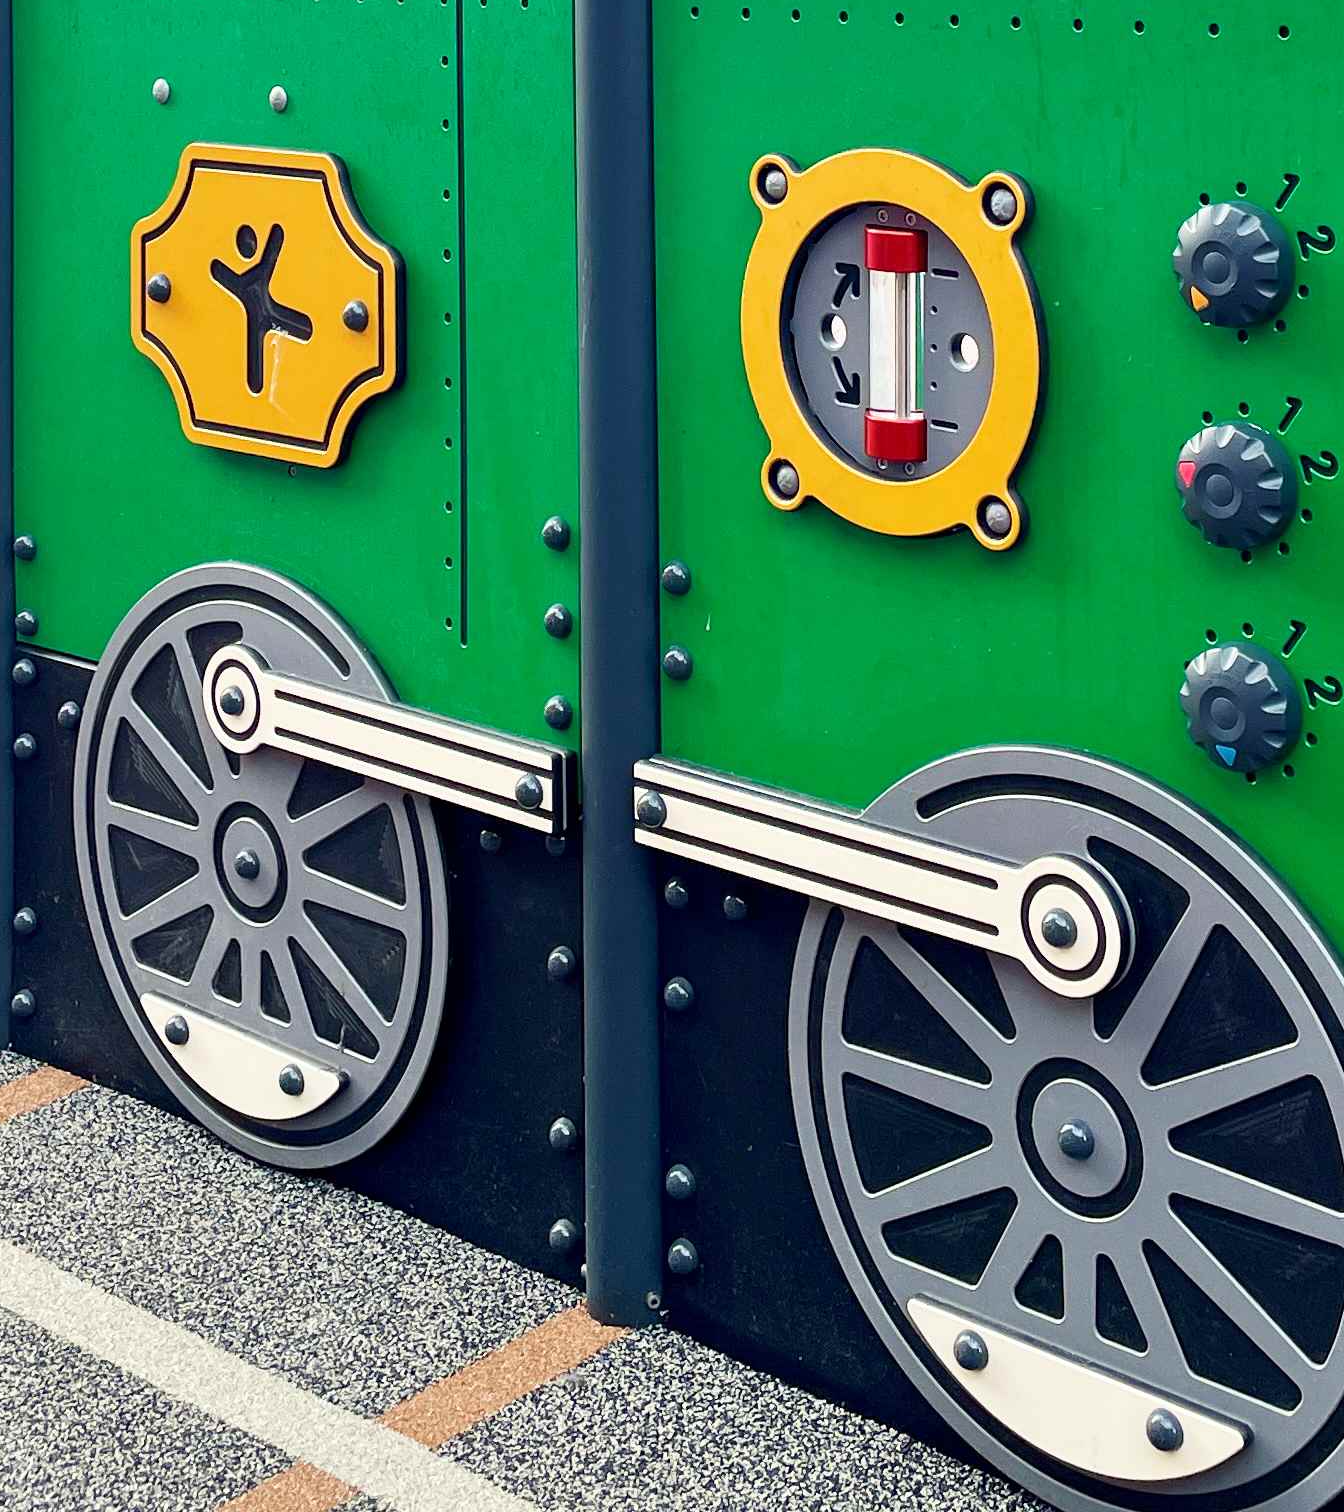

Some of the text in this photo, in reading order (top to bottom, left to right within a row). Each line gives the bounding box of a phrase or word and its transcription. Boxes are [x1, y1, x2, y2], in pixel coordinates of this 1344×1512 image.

[1275, 173, 1337, 262] 1 2
[1277, 396, 1340, 486] 1 2
[1281, 619, 1343, 710] 1 2
